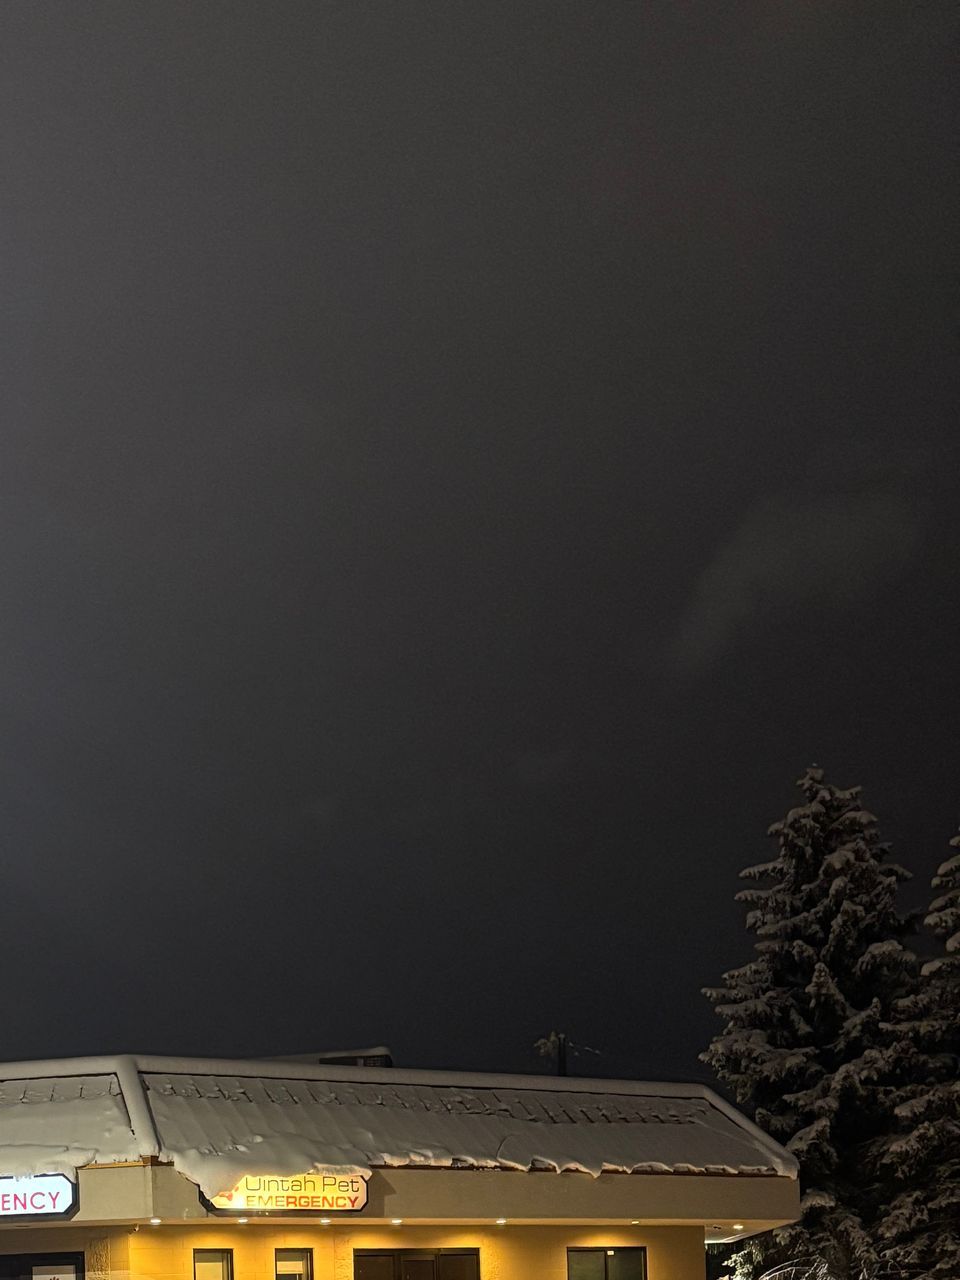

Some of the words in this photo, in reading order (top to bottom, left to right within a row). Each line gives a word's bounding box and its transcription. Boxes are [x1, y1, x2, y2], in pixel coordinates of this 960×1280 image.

[245, 1176, 316, 1193] Uintah
[322, 1176, 360, 1193] Pet
[245, 1195, 360, 1209] EMERGENCY
